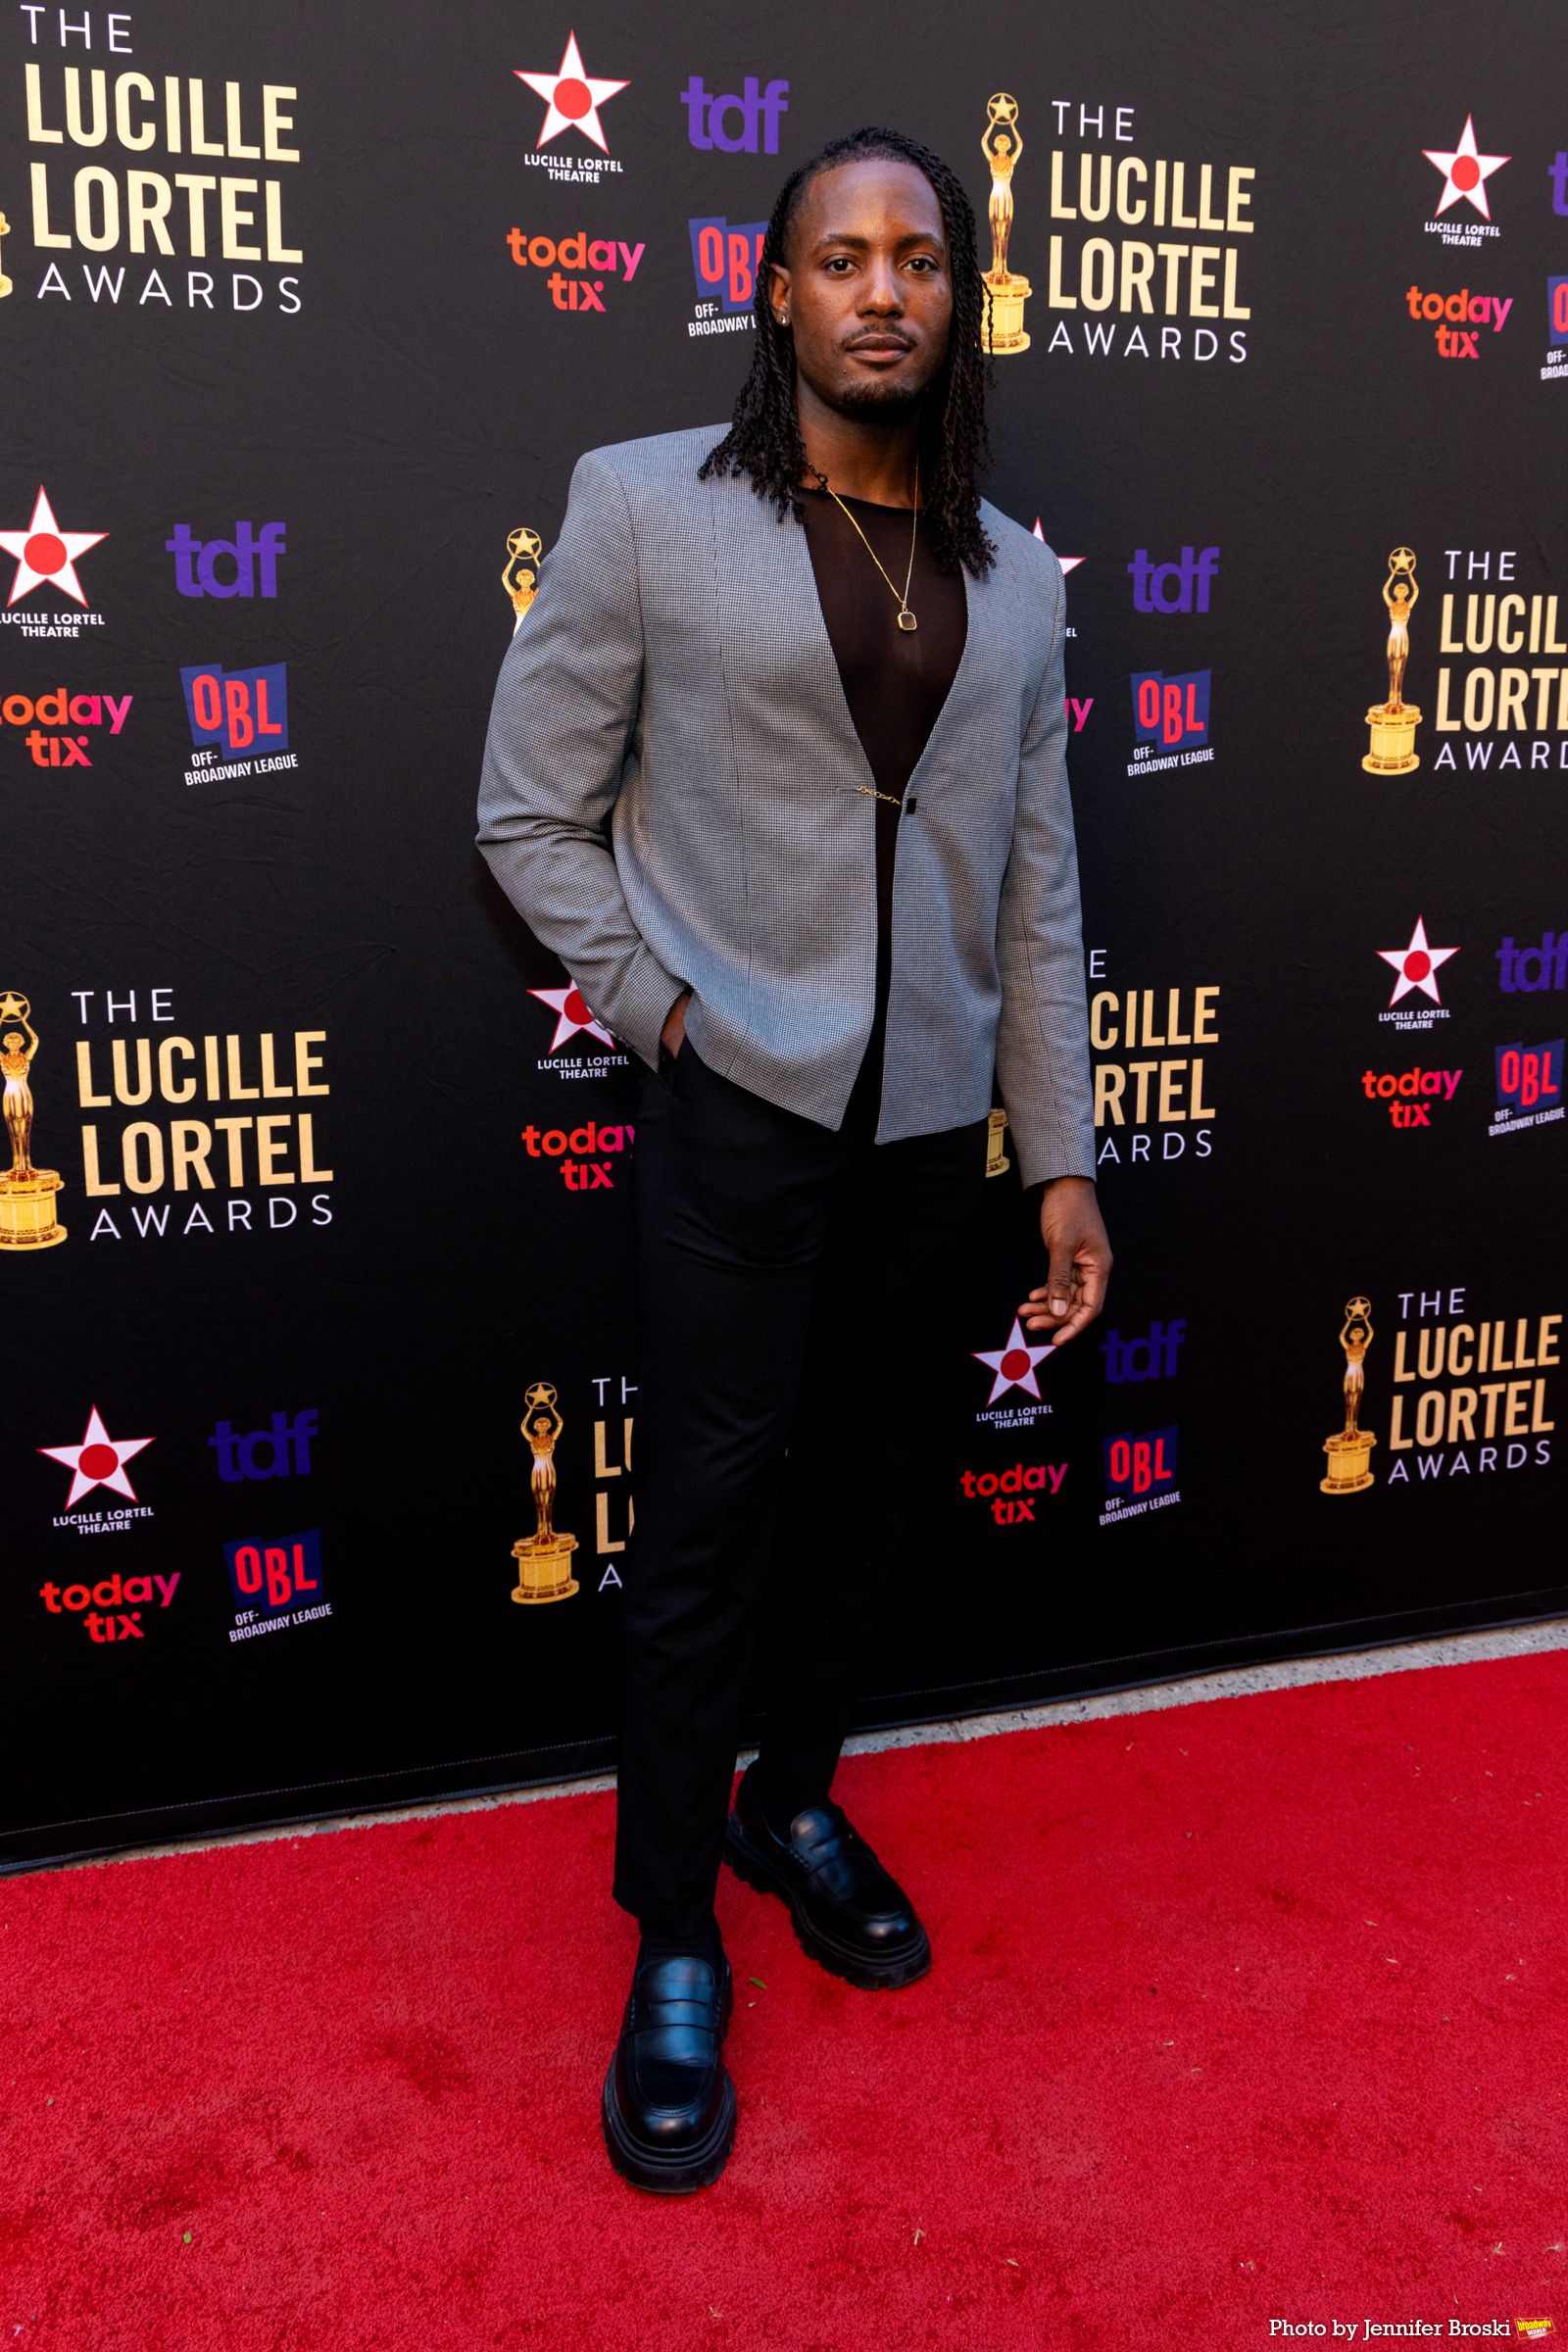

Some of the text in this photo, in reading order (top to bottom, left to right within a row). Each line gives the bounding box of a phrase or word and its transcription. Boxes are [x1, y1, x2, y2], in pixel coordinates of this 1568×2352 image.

[21, 5, 132, 53] THE
[25, 63, 300, 162] LUCILLE
[680, 75, 789, 154] tdf
[1052, 101, 1134, 141] THE
[524, 154, 623, 172] LUCILLE LORTEL
[548, 170, 600, 183] THEATRE
[1051, 151, 1255, 232] LUCILLE
[30, 163, 303, 263] LORTEL
[1424, 221, 1500, 237] LUCILLE LORTEL
[507, 227, 645, 281] today
[1442, 234, 1482, 246] THEATRE
[37, 263, 301, 314] AWARDS
[547, 272, 606, 312] tix
[1049, 235, 1250, 319] LORTEL
[688, 316, 748, 336] BROADWAY
[695, 303, 718, 318] OFF-
[1406, 286, 1513, 331] today
[1048, 320, 1247, 363] AWARDS
[1435, 324, 1479, 359] tix
[1546, 350, 1566, 365] OFF-
[1541, 365, 1568, 380] BROAD
[166, 520, 286, 598] tdf
[1445, 551, 1517, 581] THE
[1128, 546, 1220, 613] tdf
[0, 613, 105, 625] UCILLE LORTEL
[21, 626, 79, 637] THEATRE
[1440, 593, 1568, 654] LUCIL
[0, 688, 133, 734] oday
[192, 674, 282, 749] OBL
[1139, 679, 1204, 745] OBL
[1436, 666, 1568, 732] LORT
[25, 730, 92, 766] tix
[191, 752, 219, 767] OFF-
[1127, 748, 1214, 777] BROADWAY LEAGUE
[1134, 747, 1154, 760] OFF-
[1434, 741, 1568, 770] AWAR
[184, 754, 298, 786] BROADWAY LEAGUE
[71, 988, 174, 1024] THE
[1090, 986, 1220, 1051] CILLE
[1379, 1009, 1450, 1021] LUCILLE LORTEL
[1396, 1020, 1433, 1030] THEATRE
[75, 1030, 330, 1108] LUCILLE
[537, 1055, 629, 1069] LUCILLE LORTEL
[560, 1067, 608, 1079] THEATRE
[1500, 1050, 1558, 1106] OBL
[1094, 1058, 1216, 1127] RTEL
[1362, 1067, 1463, 1101] today
[1389, 1100, 1431, 1128] tix
[1489, 1106, 1566, 1137] BROADWAY LEAGUE
[1494, 1108, 1513, 1122] OFF-
[81, 1113, 333, 1197] LORTEL
[521, 1121, 635, 1157] toda
[1098, 1129, 1212, 1165] ARDS
[560, 1158, 614, 1191] tix
[90, 1194, 333, 1242] AWARDS
[1397, 1288, 1466, 1319] THE
[1100, 1318, 1187, 1384] tdf
[1394, 1314, 1563, 1383] LUCILLE
[592, 1376, 638, 1406] TH
[976, 1404, 1054, 1422] LUCILLE LORTEL
[994, 1416, 1035, 1429] THEATRE
[1390, 1378, 1555, 1450] LORTEL
[208, 1408, 318, 1483] tdf
[1388, 1440, 1550, 1485] AWARDS
[960, 1463, 1069, 1498] today
[1110, 1438, 1172, 1494] OBL
[53, 1506, 154, 1527] LUCILLE LORTEL
[991, 1497, 1036, 1526] tix
[1099, 1491, 1181, 1527] BROADWAY LEAGUE
[1104, 1496, 1125, 1512] OFF-
[77, 1520, 131, 1535] THEATRE
[39, 1572, 181, 1614] today
[234, 1544, 318, 1606] OBL
[84, 1612, 145, 1643] tix
[228, 1603, 333, 1643] BROADWAY LEAGUE
[234, 1610, 260, 1627] OFF-
